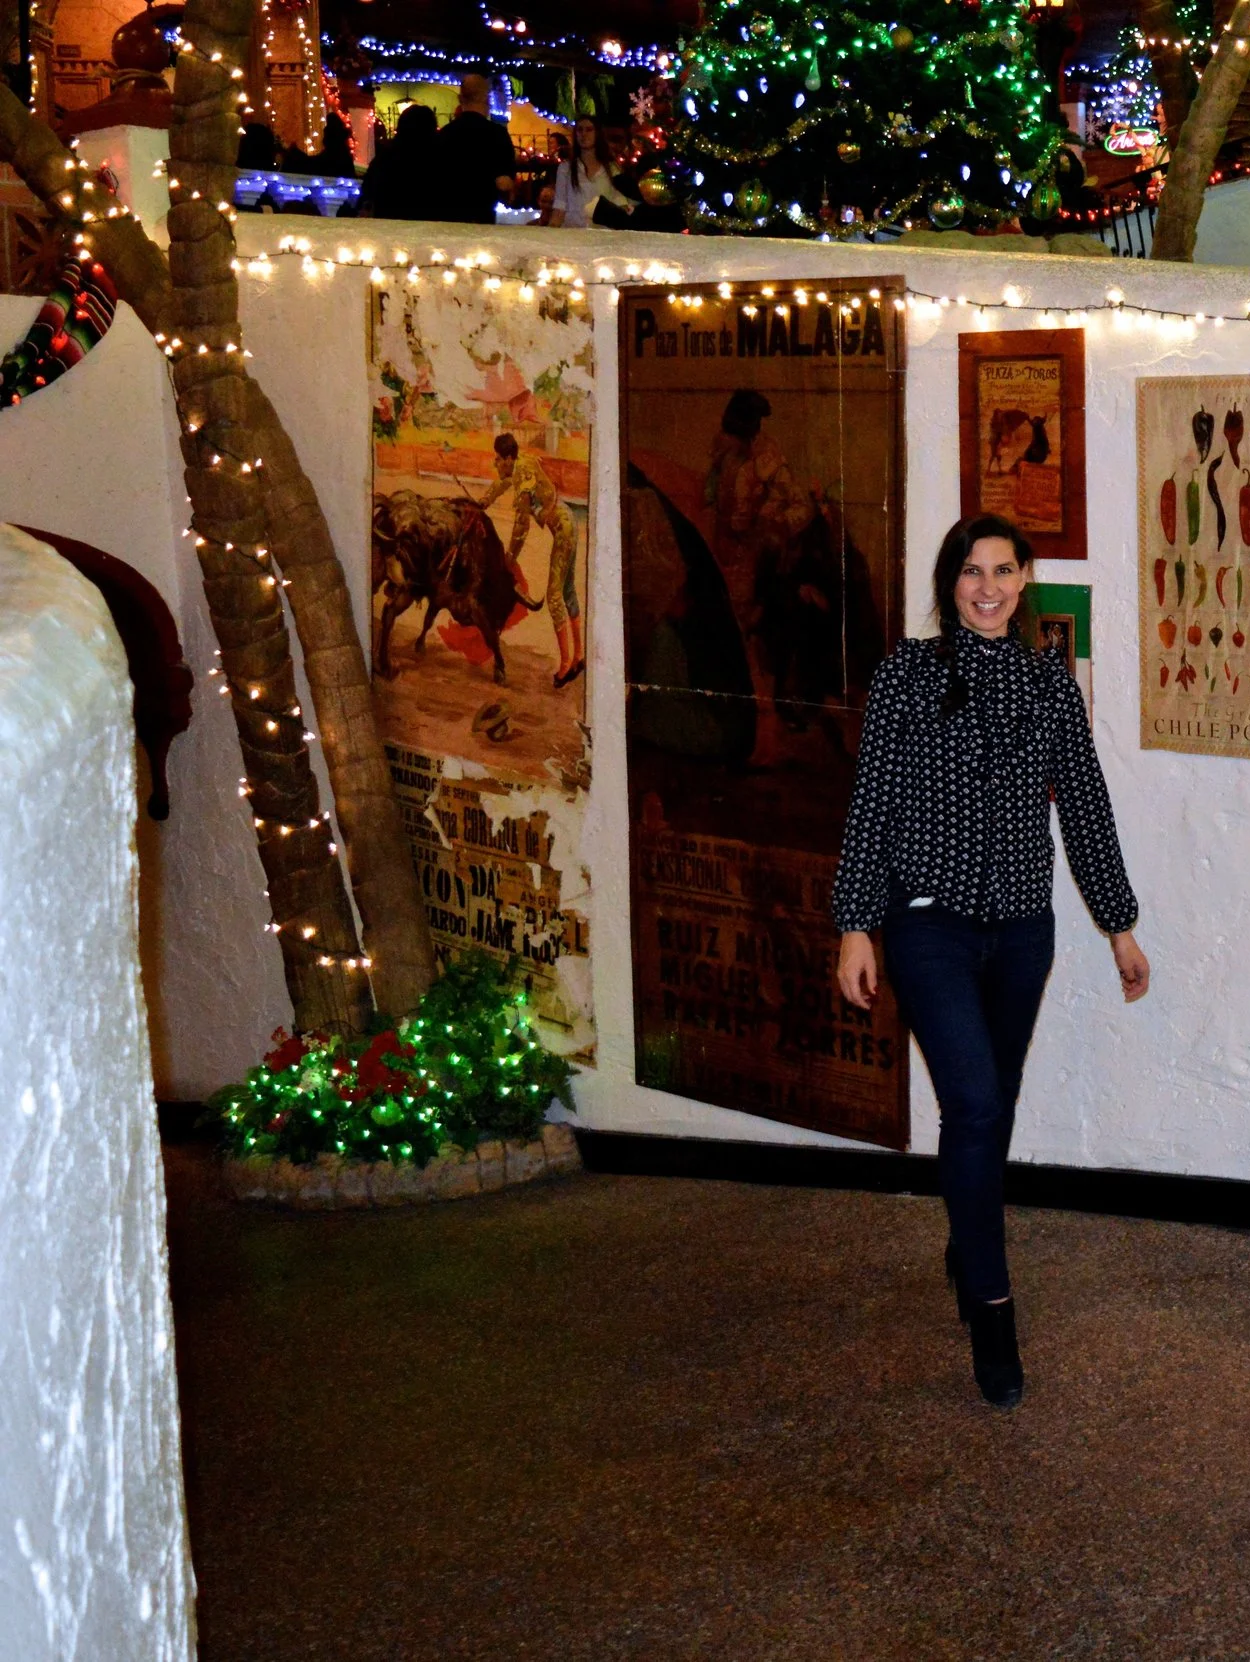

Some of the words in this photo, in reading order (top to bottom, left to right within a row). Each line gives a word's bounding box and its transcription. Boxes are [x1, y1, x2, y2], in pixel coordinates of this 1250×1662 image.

[635, 308, 677, 357] Plaza
[682, 322, 716, 357] Toros
[720, 323, 733, 357] de
[984, 366, 1013, 380] PLAZA
[1024, 366, 1057, 381] TOROS
[1192, 702, 1219, 717] The
[1154, 719, 1220, 738] CHILE
[657, 918, 721, 958] RUIZ
